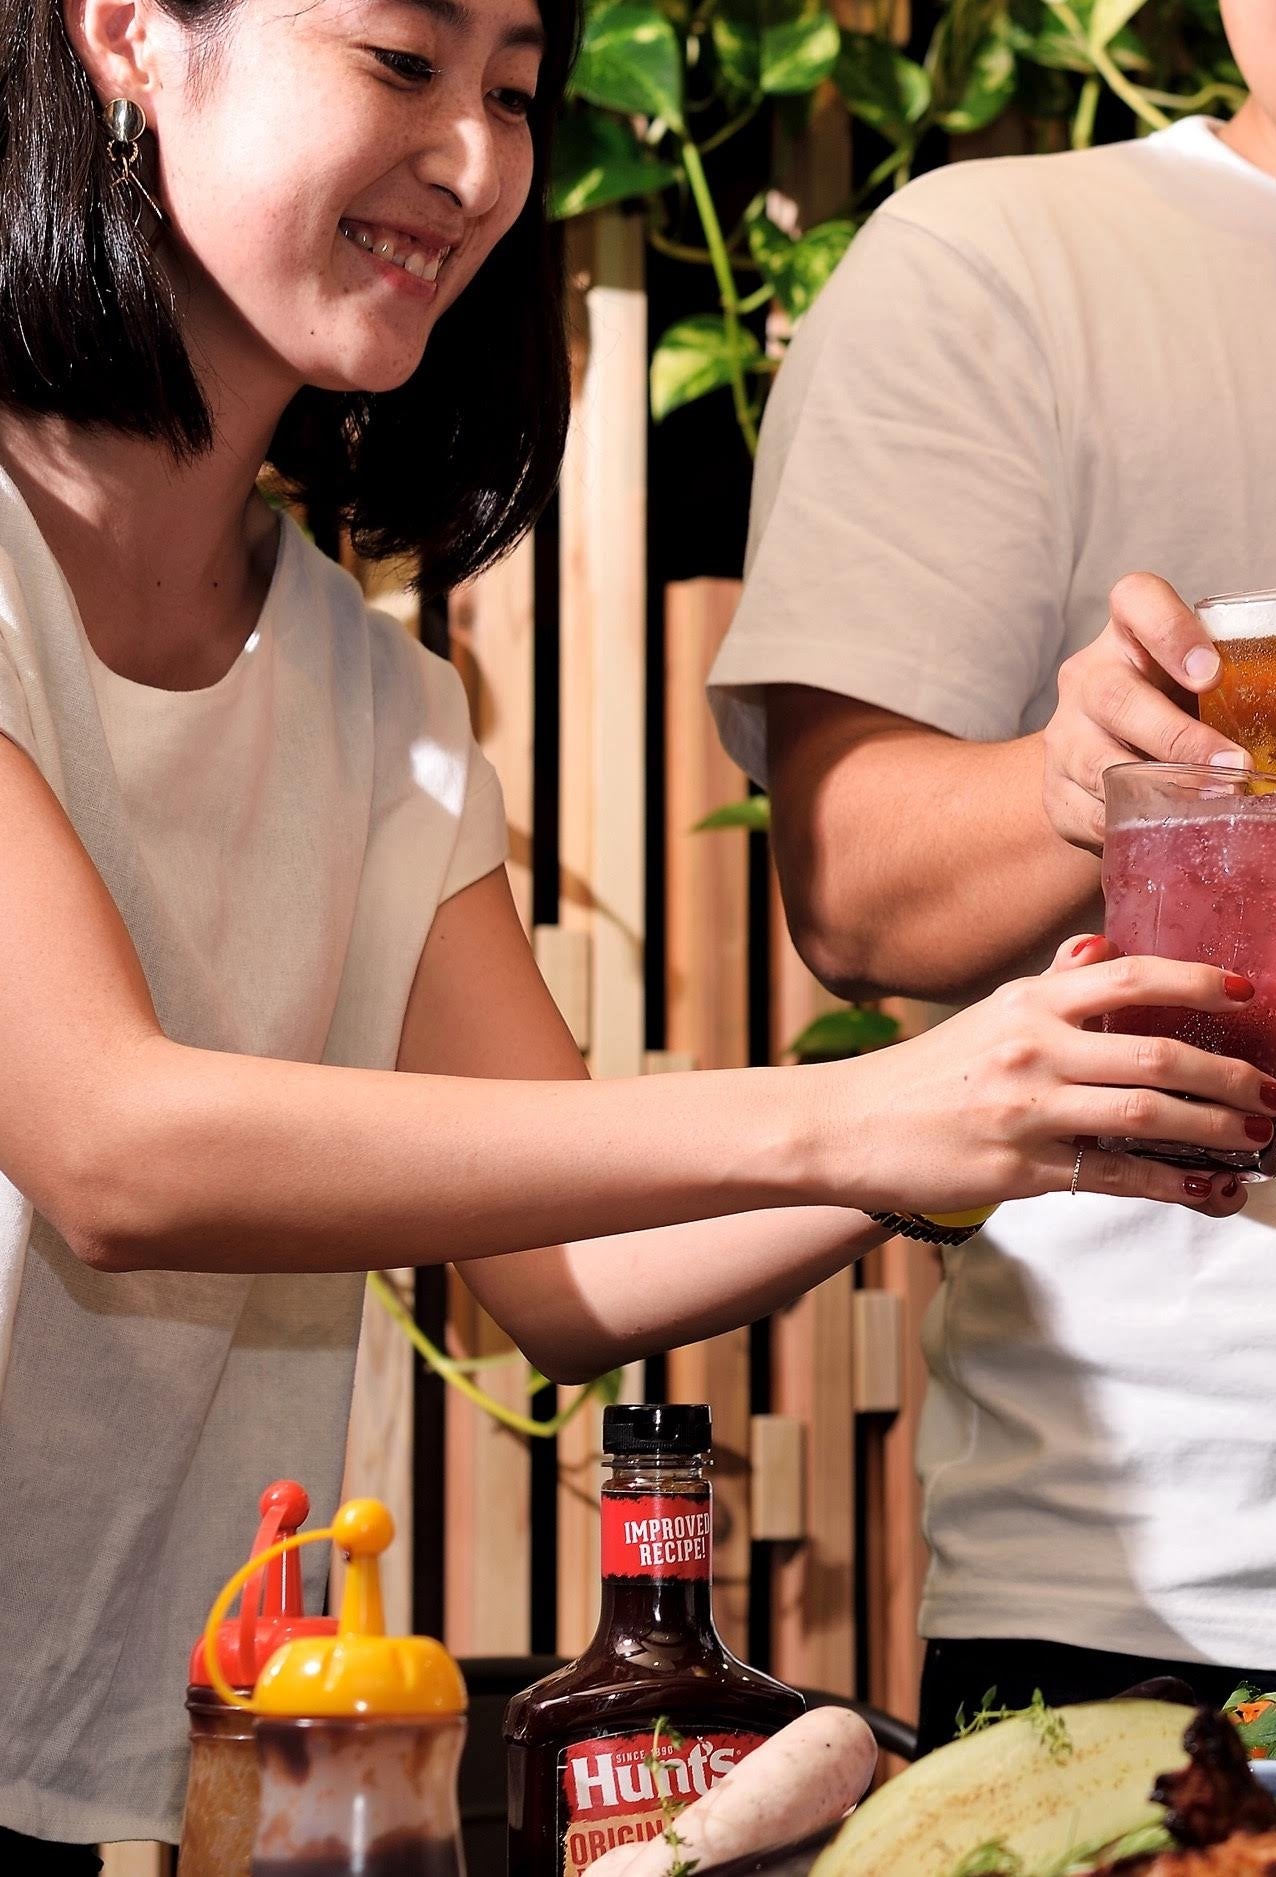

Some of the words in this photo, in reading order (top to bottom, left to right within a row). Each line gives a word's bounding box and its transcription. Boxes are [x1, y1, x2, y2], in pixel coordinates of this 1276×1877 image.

[623, 1512, 710, 1545] IMPROVED
[639, 1536, 706, 1567] RECIPE!
[615, 1749, 646, 1764] SINCE
[650, 1745, 674, 1758] 890
[571, 1736, 737, 1811] Hunt's
